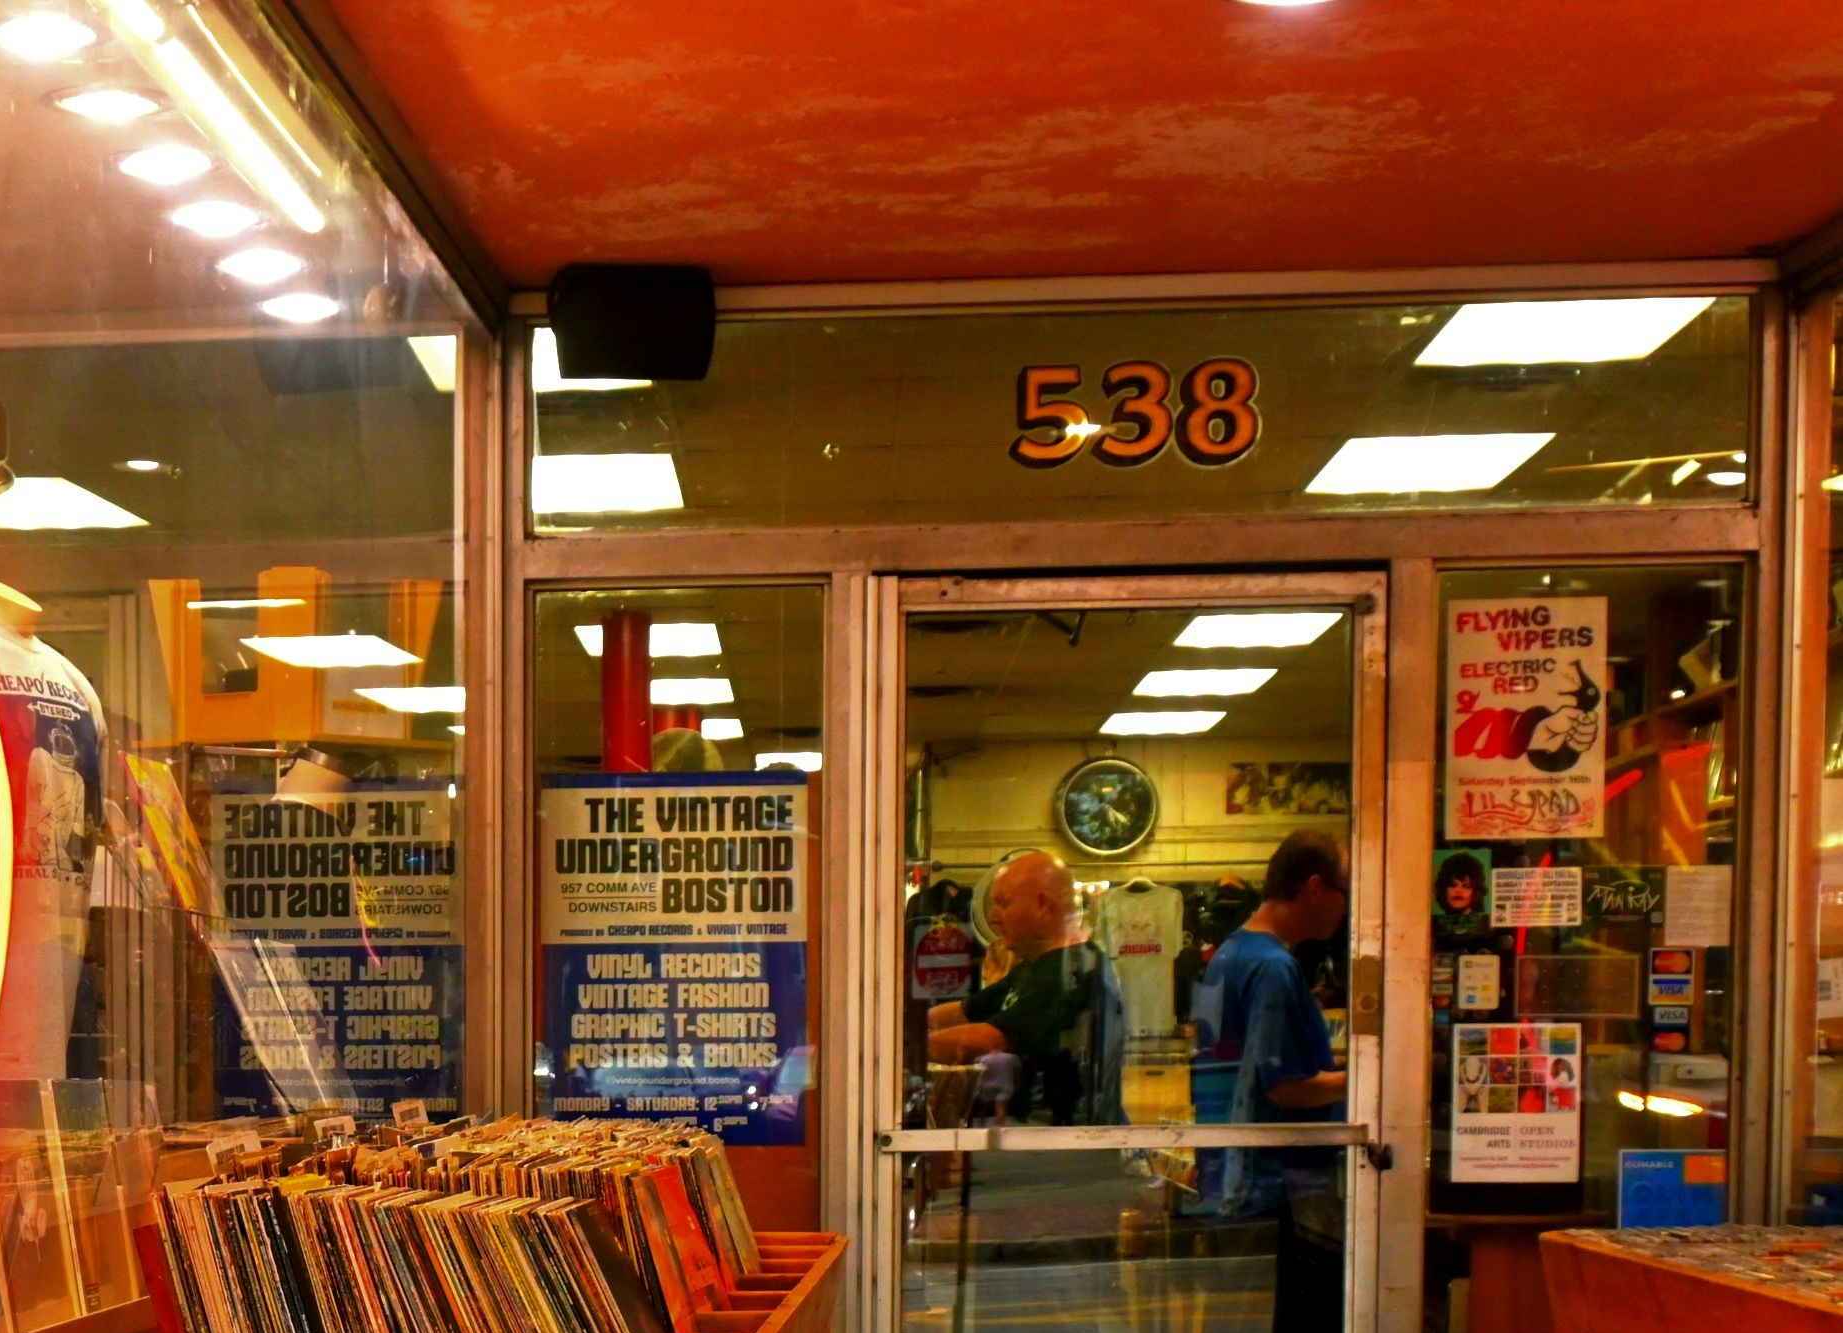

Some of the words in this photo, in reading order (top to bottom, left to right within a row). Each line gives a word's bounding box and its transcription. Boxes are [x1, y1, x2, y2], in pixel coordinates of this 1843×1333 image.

[1008, 355, 1262, 469] 538
[1456, 605, 1551, 632] FLYING
[1497, 626, 1595, 652] VIPERS
[1460, 657, 1557, 679] ELECTRIC
[1493, 675, 1539, 694] RED
[39, 703, 72, 718] STEREO
[585, 797, 645, 833] THE
[656, 795, 794, 832] VINTAGE
[555, 836, 794, 874] UNDERGROUND
[586, 882, 627, 893] COMM
[631, 881, 657, 893] AVE
[662, 877, 794, 913] BOSTON
[568, 901, 657, 913] DOWNSTAIRS
[608, 924, 647, 937] CHEAPO
[649, 924, 693, 936] RECORDS
[746, 923, 788, 935] VINTAGE
[587, 953, 652, 979] VINYL
[660, 952, 761, 979] RECORDS
[577, 982, 670, 1009] VINTAGE
[676, 982, 770, 1009] FASHION
[571, 1013, 666, 1039] GRAPHIC
[673, 1012, 776, 1039] T-SHIRTS
[568, 1043, 669, 1070] POSTERS
[676, 1043, 695, 1069] &
[703, 1042, 779, 1069] BOOKS
[554, 1096, 611, 1112] MONDAY
[1456, 1126, 1511, 1136] CAMBRIDGE
[1486, 1139, 1511, 1149] ARTS
